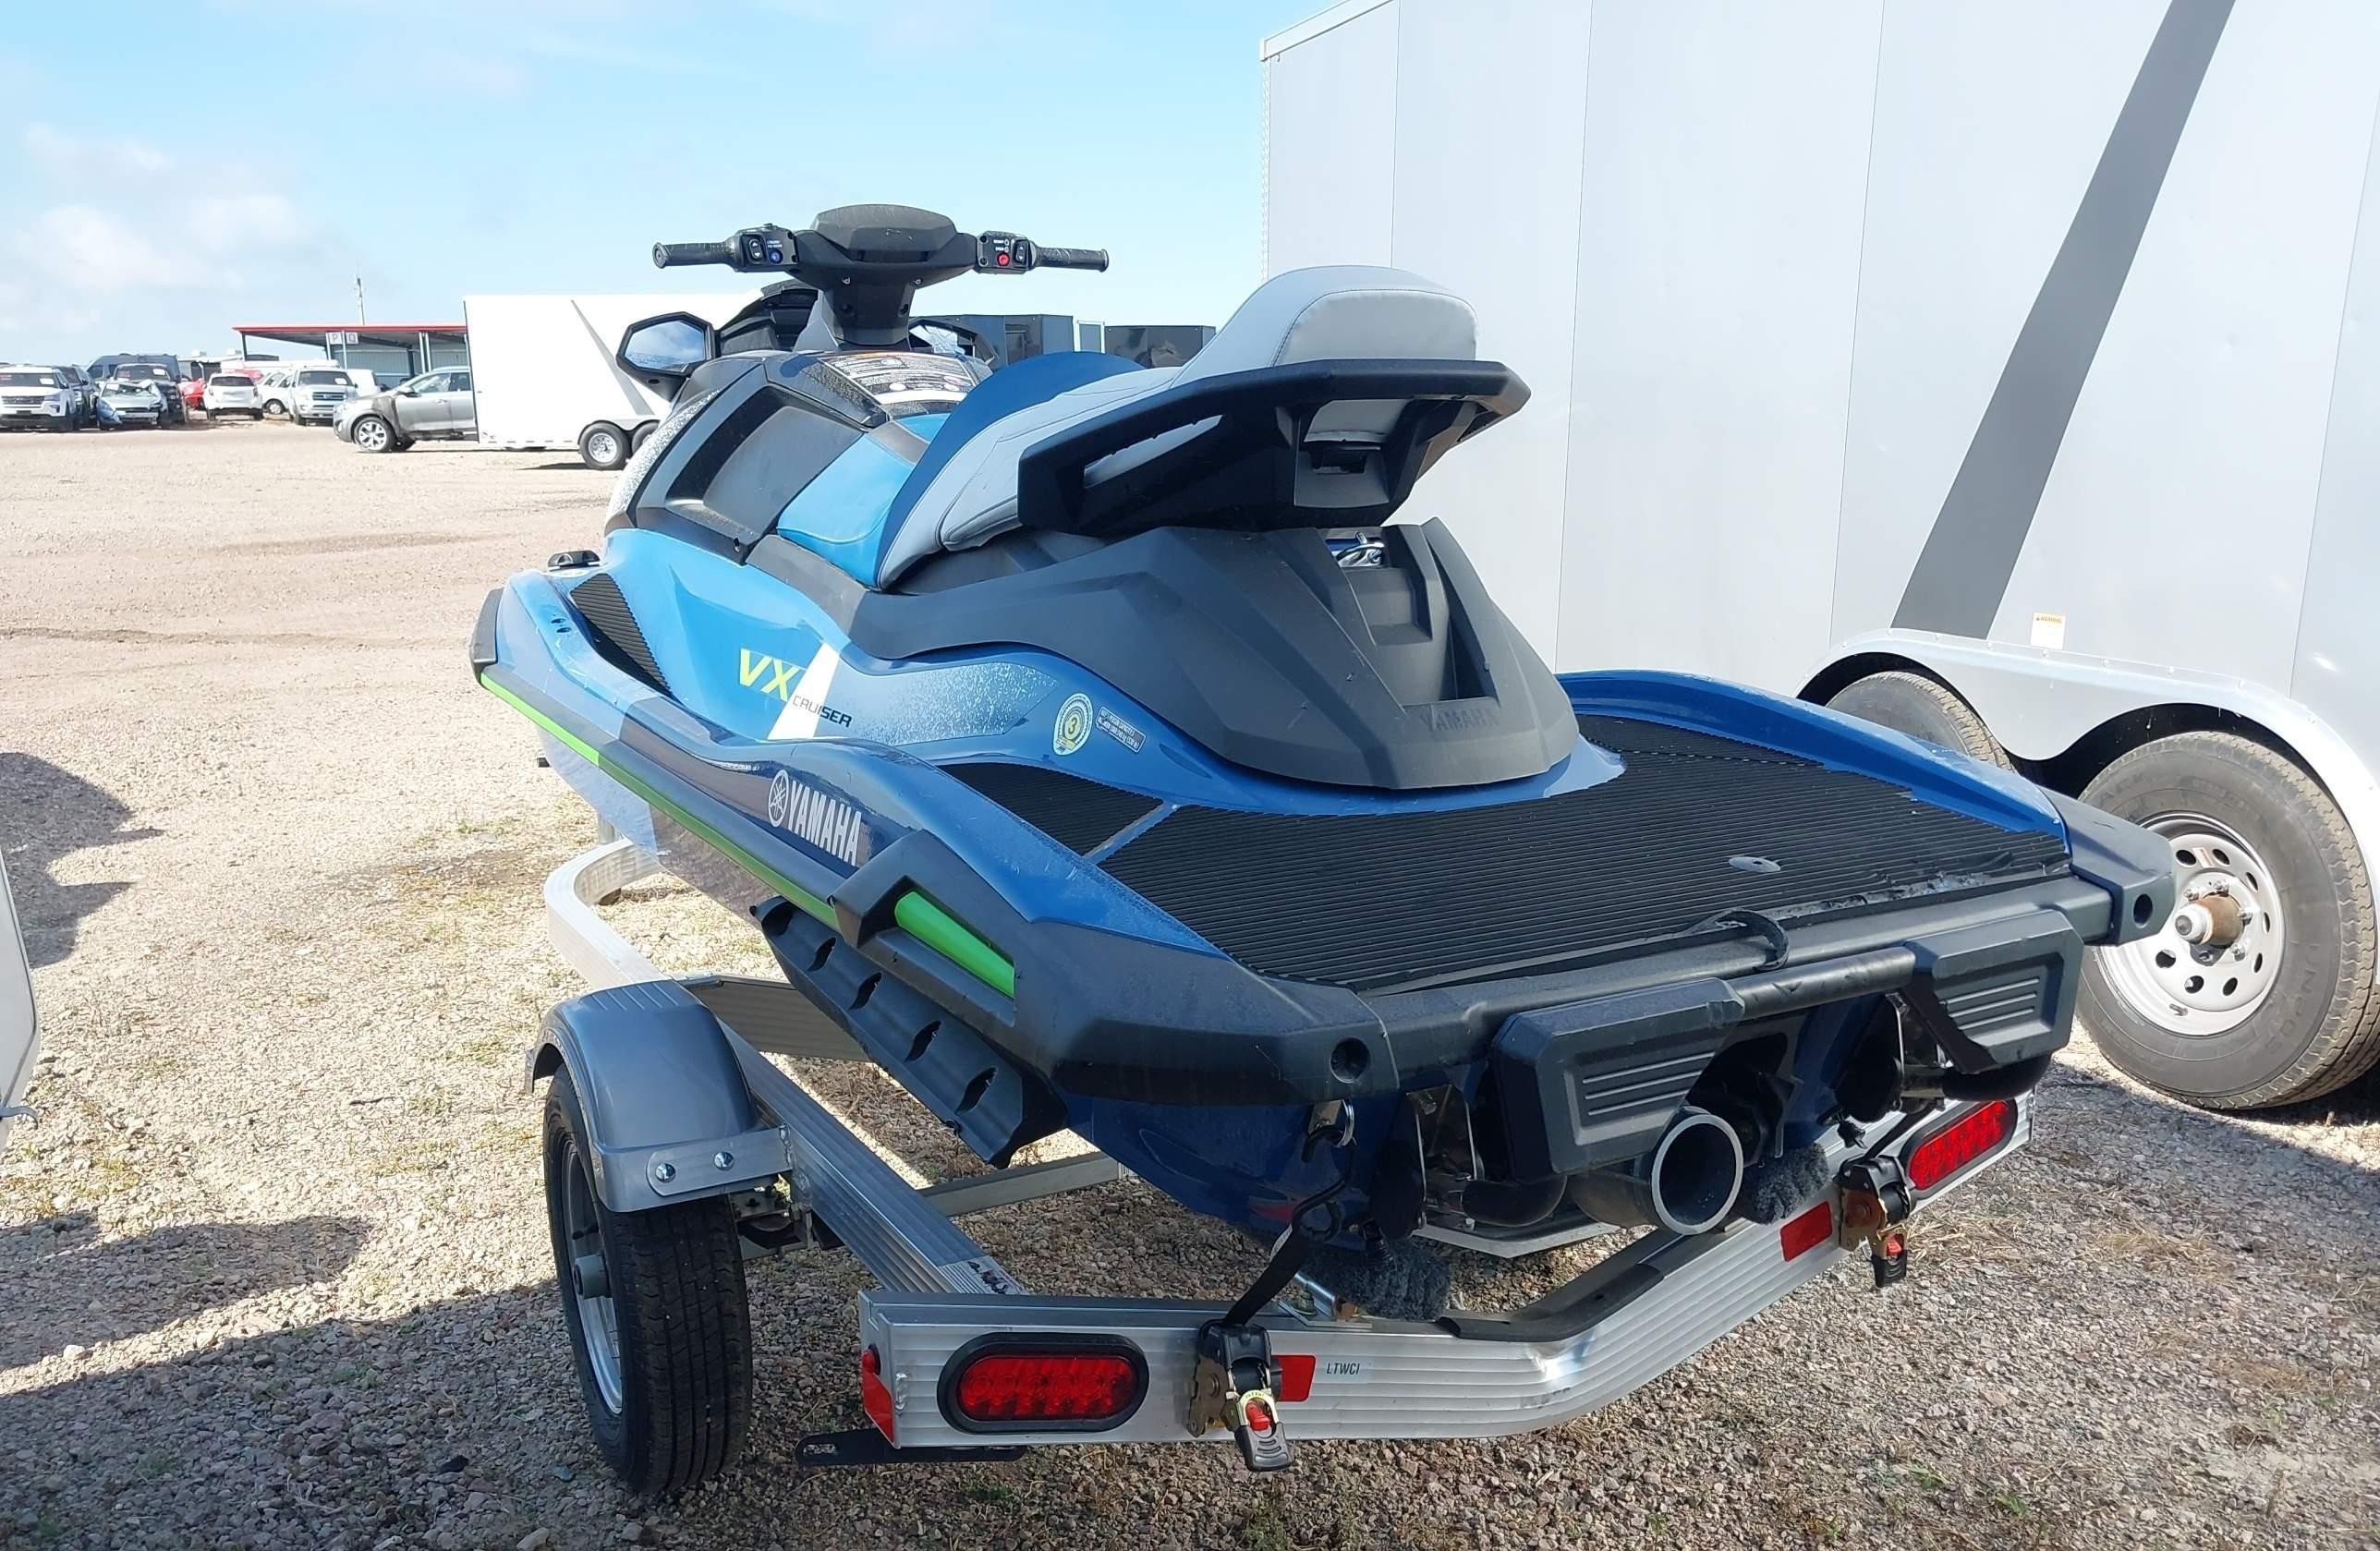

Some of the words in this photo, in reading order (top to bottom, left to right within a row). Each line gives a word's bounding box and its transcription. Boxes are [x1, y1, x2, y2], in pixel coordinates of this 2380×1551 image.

[740, 648, 800, 703] VX
[793, 695, 852, 728] CRUISER
[1068, 717, 1078, 734] 3
[788, 780, 862, 866] YAMAHA
[1326, 1363, 1360, 1375] LTWCI
